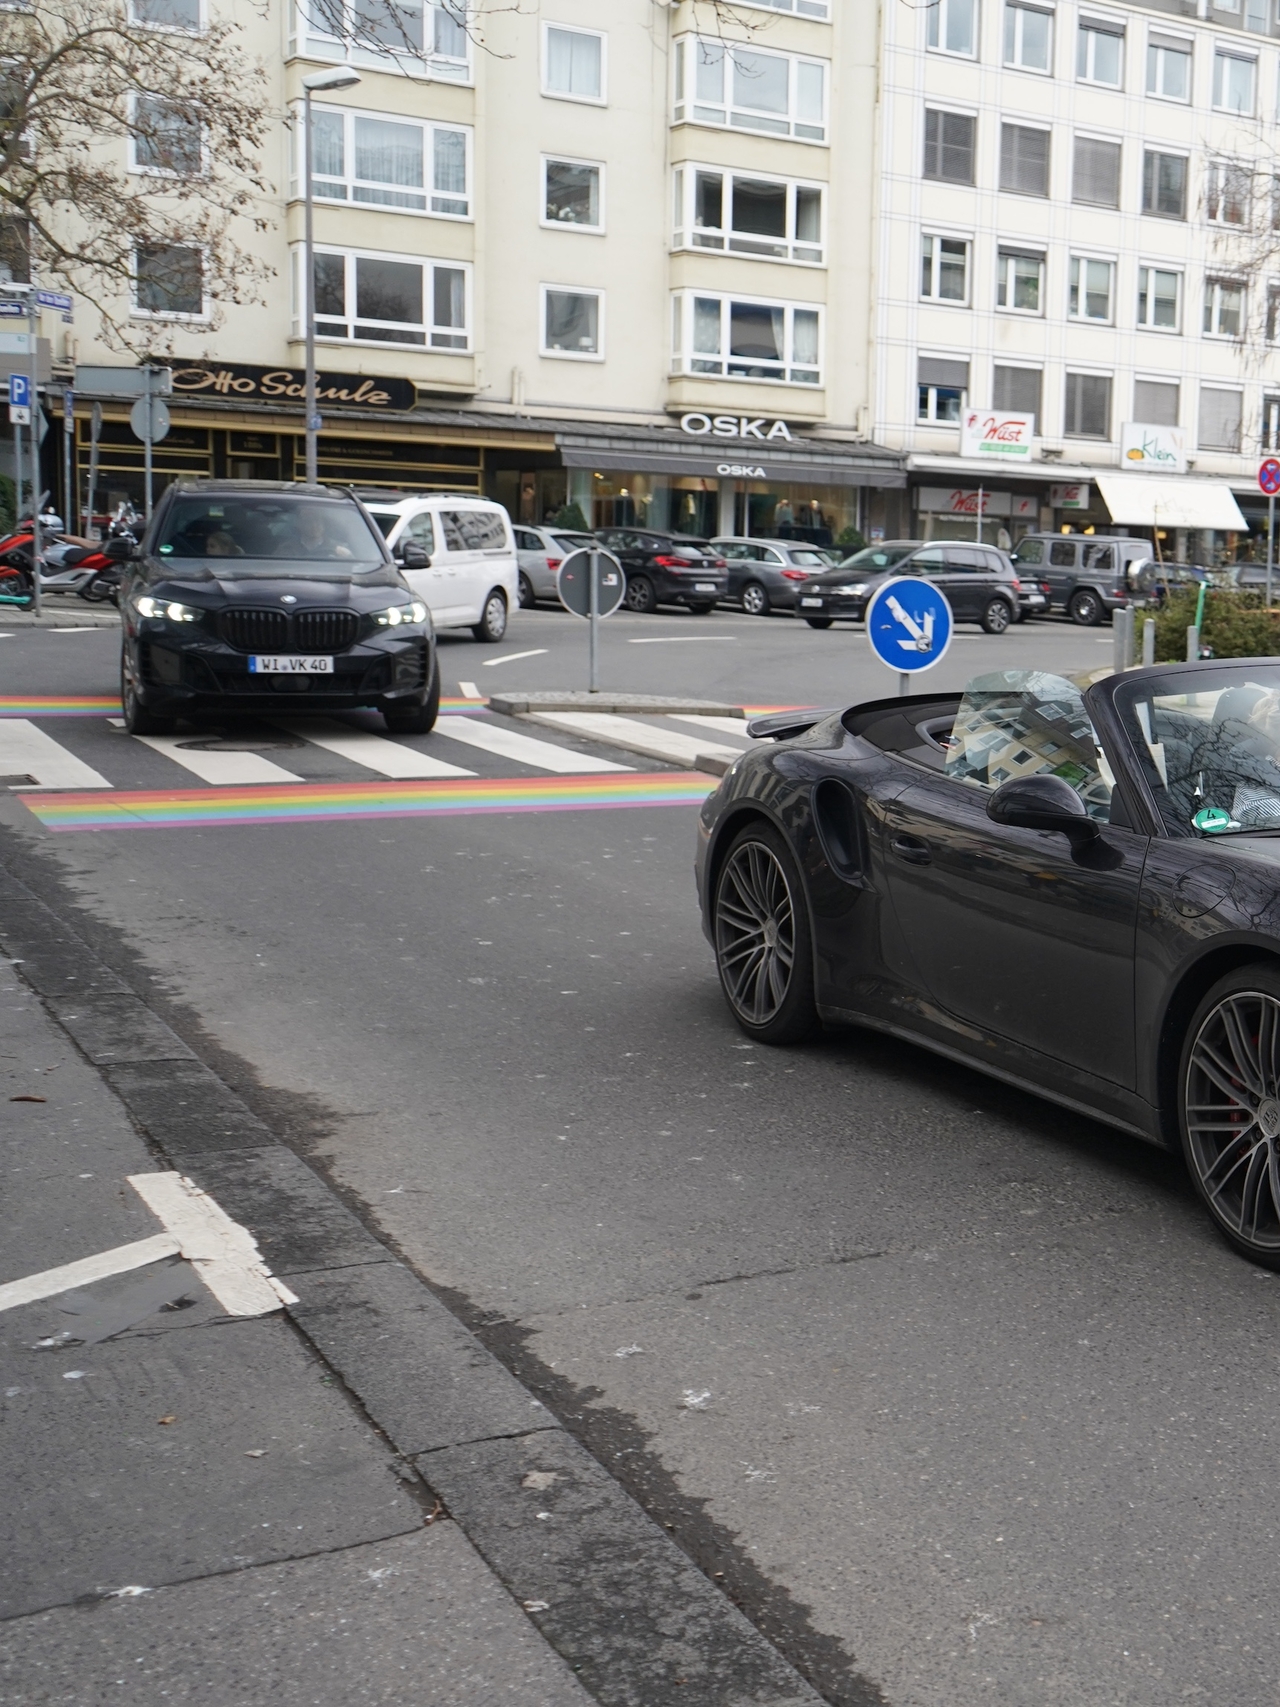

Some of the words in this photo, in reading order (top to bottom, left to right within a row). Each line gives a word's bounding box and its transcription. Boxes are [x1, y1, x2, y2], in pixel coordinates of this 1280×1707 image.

[13, 377, 25, 402] P
[171, 368, 257, 394] Otto
[681, 412, 792, 441] OSKA
[983, 417, 1026, 442] Wüst
[1143, 430, 1177, 461] Klein
[717, 464, 767, 478] OSKA
[262, 658, 279, 671] WI
[289, 658, 307, 671] VK
[310, 658, 327, 671] 40
[1207, 809, 1217, 819] 4
